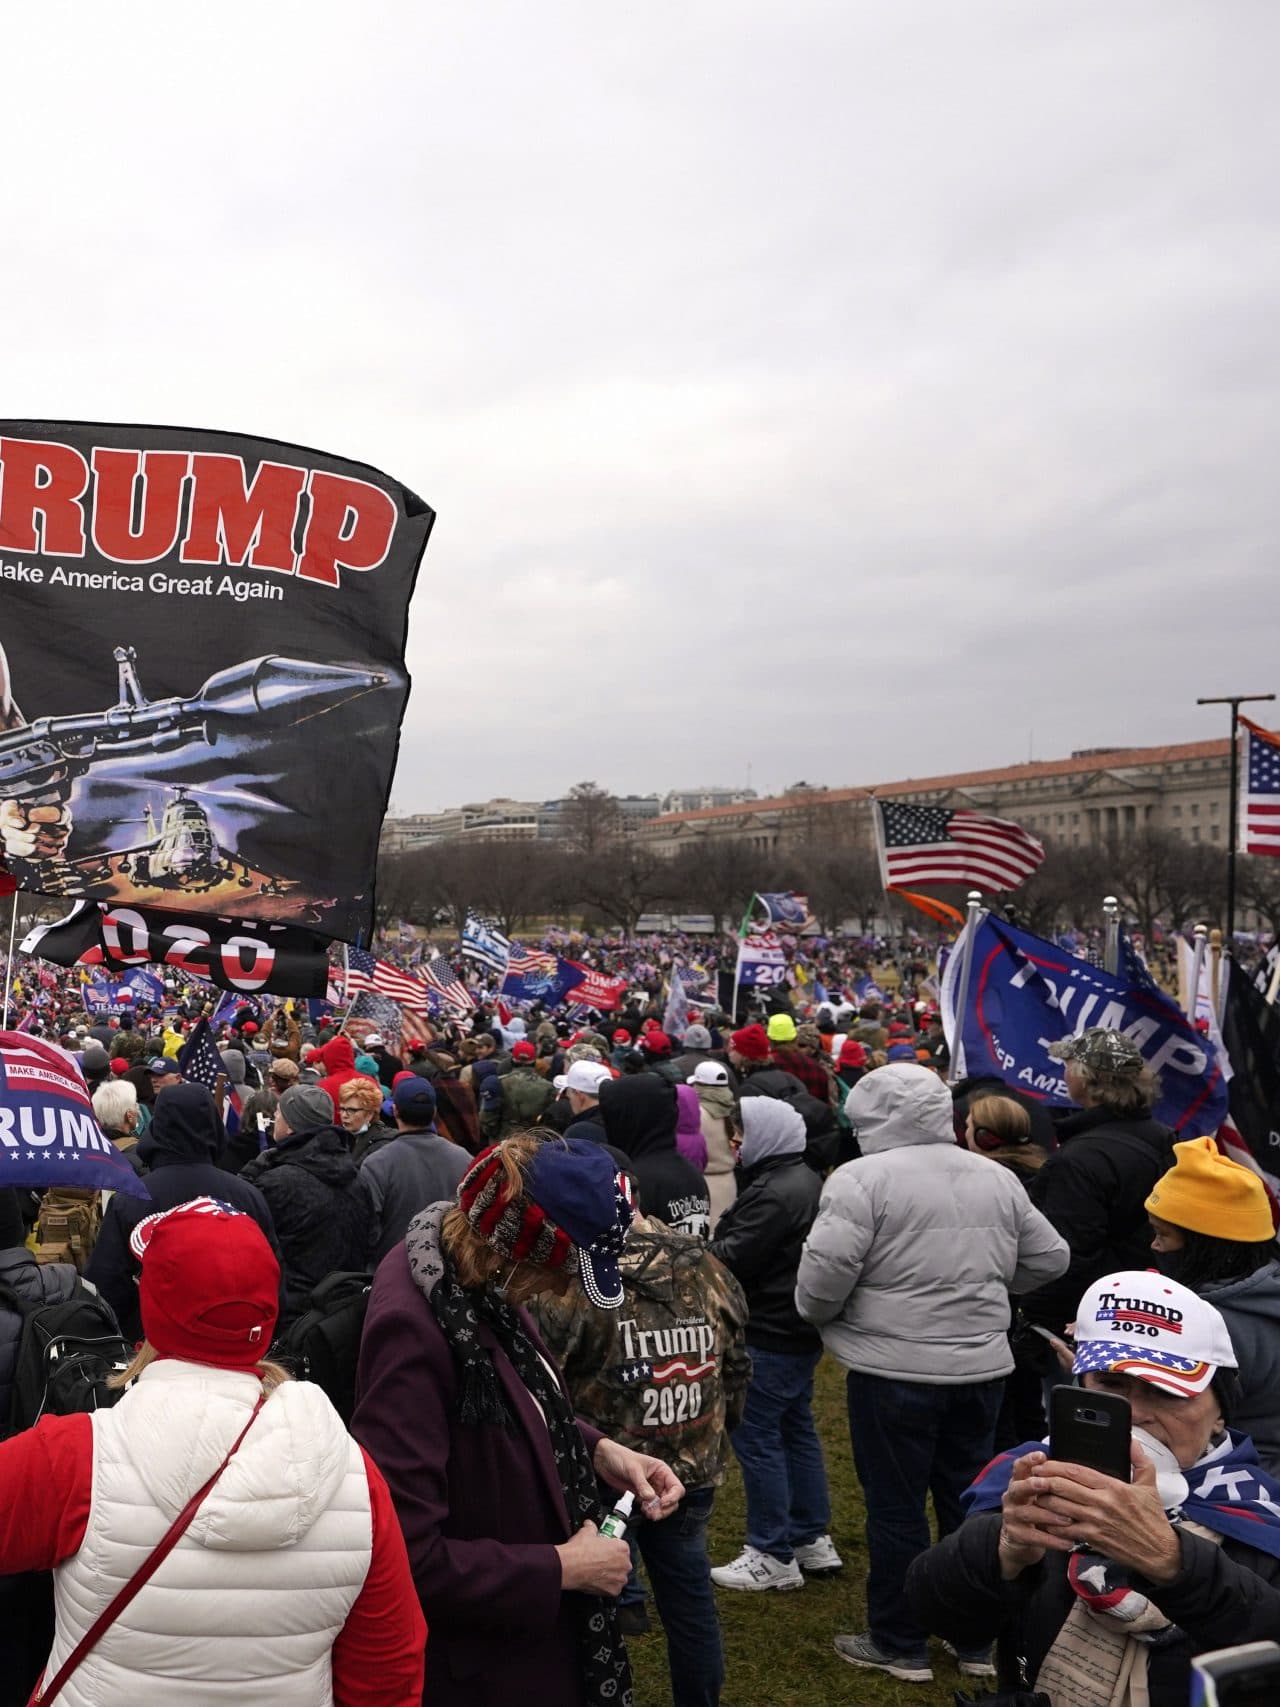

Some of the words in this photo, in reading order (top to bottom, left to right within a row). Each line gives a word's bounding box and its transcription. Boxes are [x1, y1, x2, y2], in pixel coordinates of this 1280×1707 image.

[49, 566, 144, 592] America
[148, 572, 212, 596] Great
[216, 575, 283, 601] Again
[95, 1003, 125, 1012] TEXAS
[9, 1066, 36, 1076] MAKE
[39, 1070, 70, 1085] AMERICA
[1099, 1293, 1183, 1324] Trump
[675, 1317, 705, 1326] President
[1111, 1321, 1159, 1337] 2020
[618, 1319, 714, 1363] Trump
[643, 1381, 702, 1426] 2020
